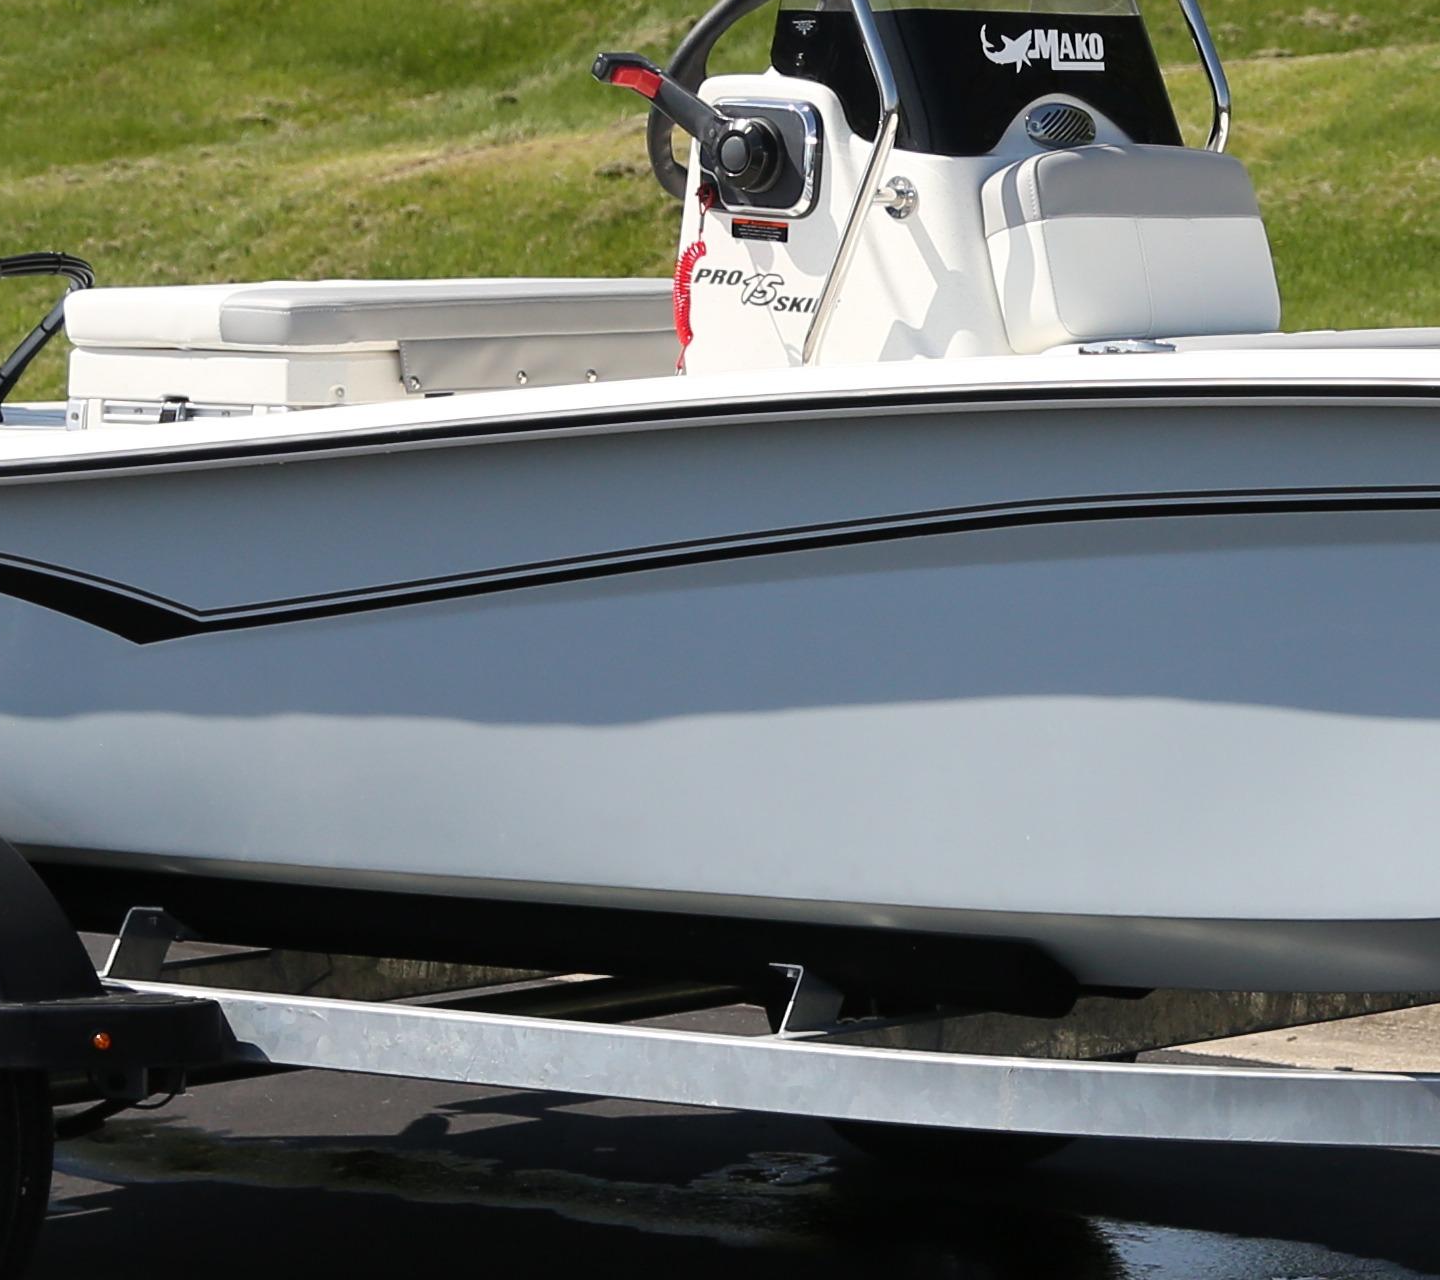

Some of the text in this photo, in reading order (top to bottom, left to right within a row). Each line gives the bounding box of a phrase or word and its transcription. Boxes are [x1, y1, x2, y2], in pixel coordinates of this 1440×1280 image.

[1027, 29, 1106, 71] MAKO
[694, 268, 743, 285] PRO
[741, 273, 785, 306] 15
